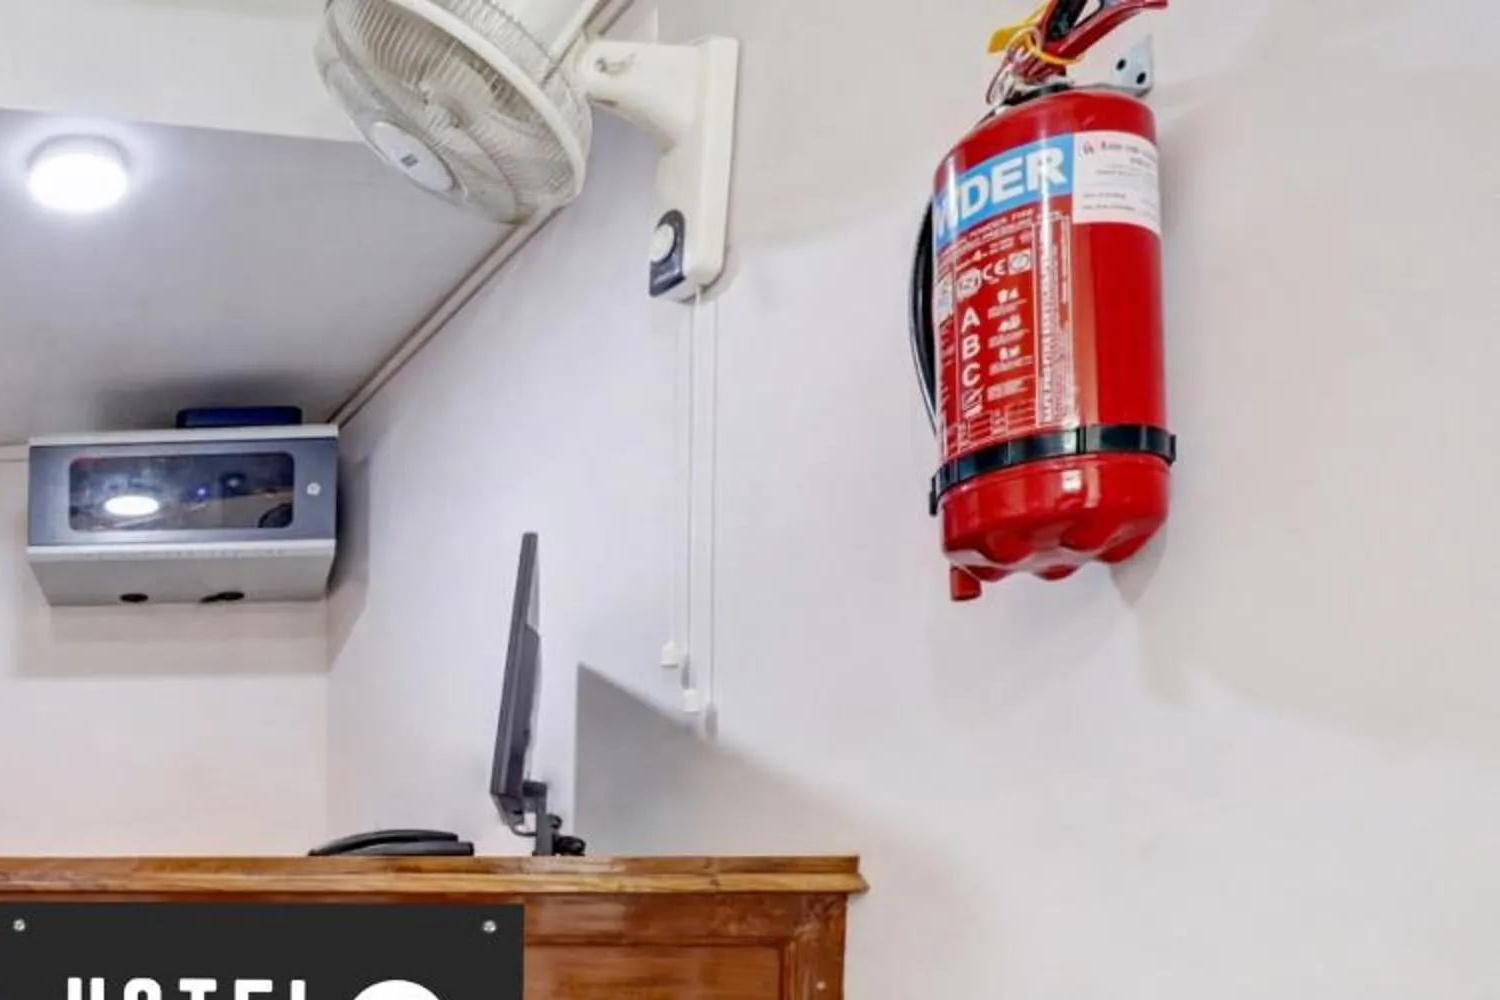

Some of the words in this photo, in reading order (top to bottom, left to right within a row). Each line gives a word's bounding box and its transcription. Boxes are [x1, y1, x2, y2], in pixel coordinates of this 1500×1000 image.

[961, 306, 981, 333] A
[961, 334, 981, 361] B
[961, 363, 981, 387] C
